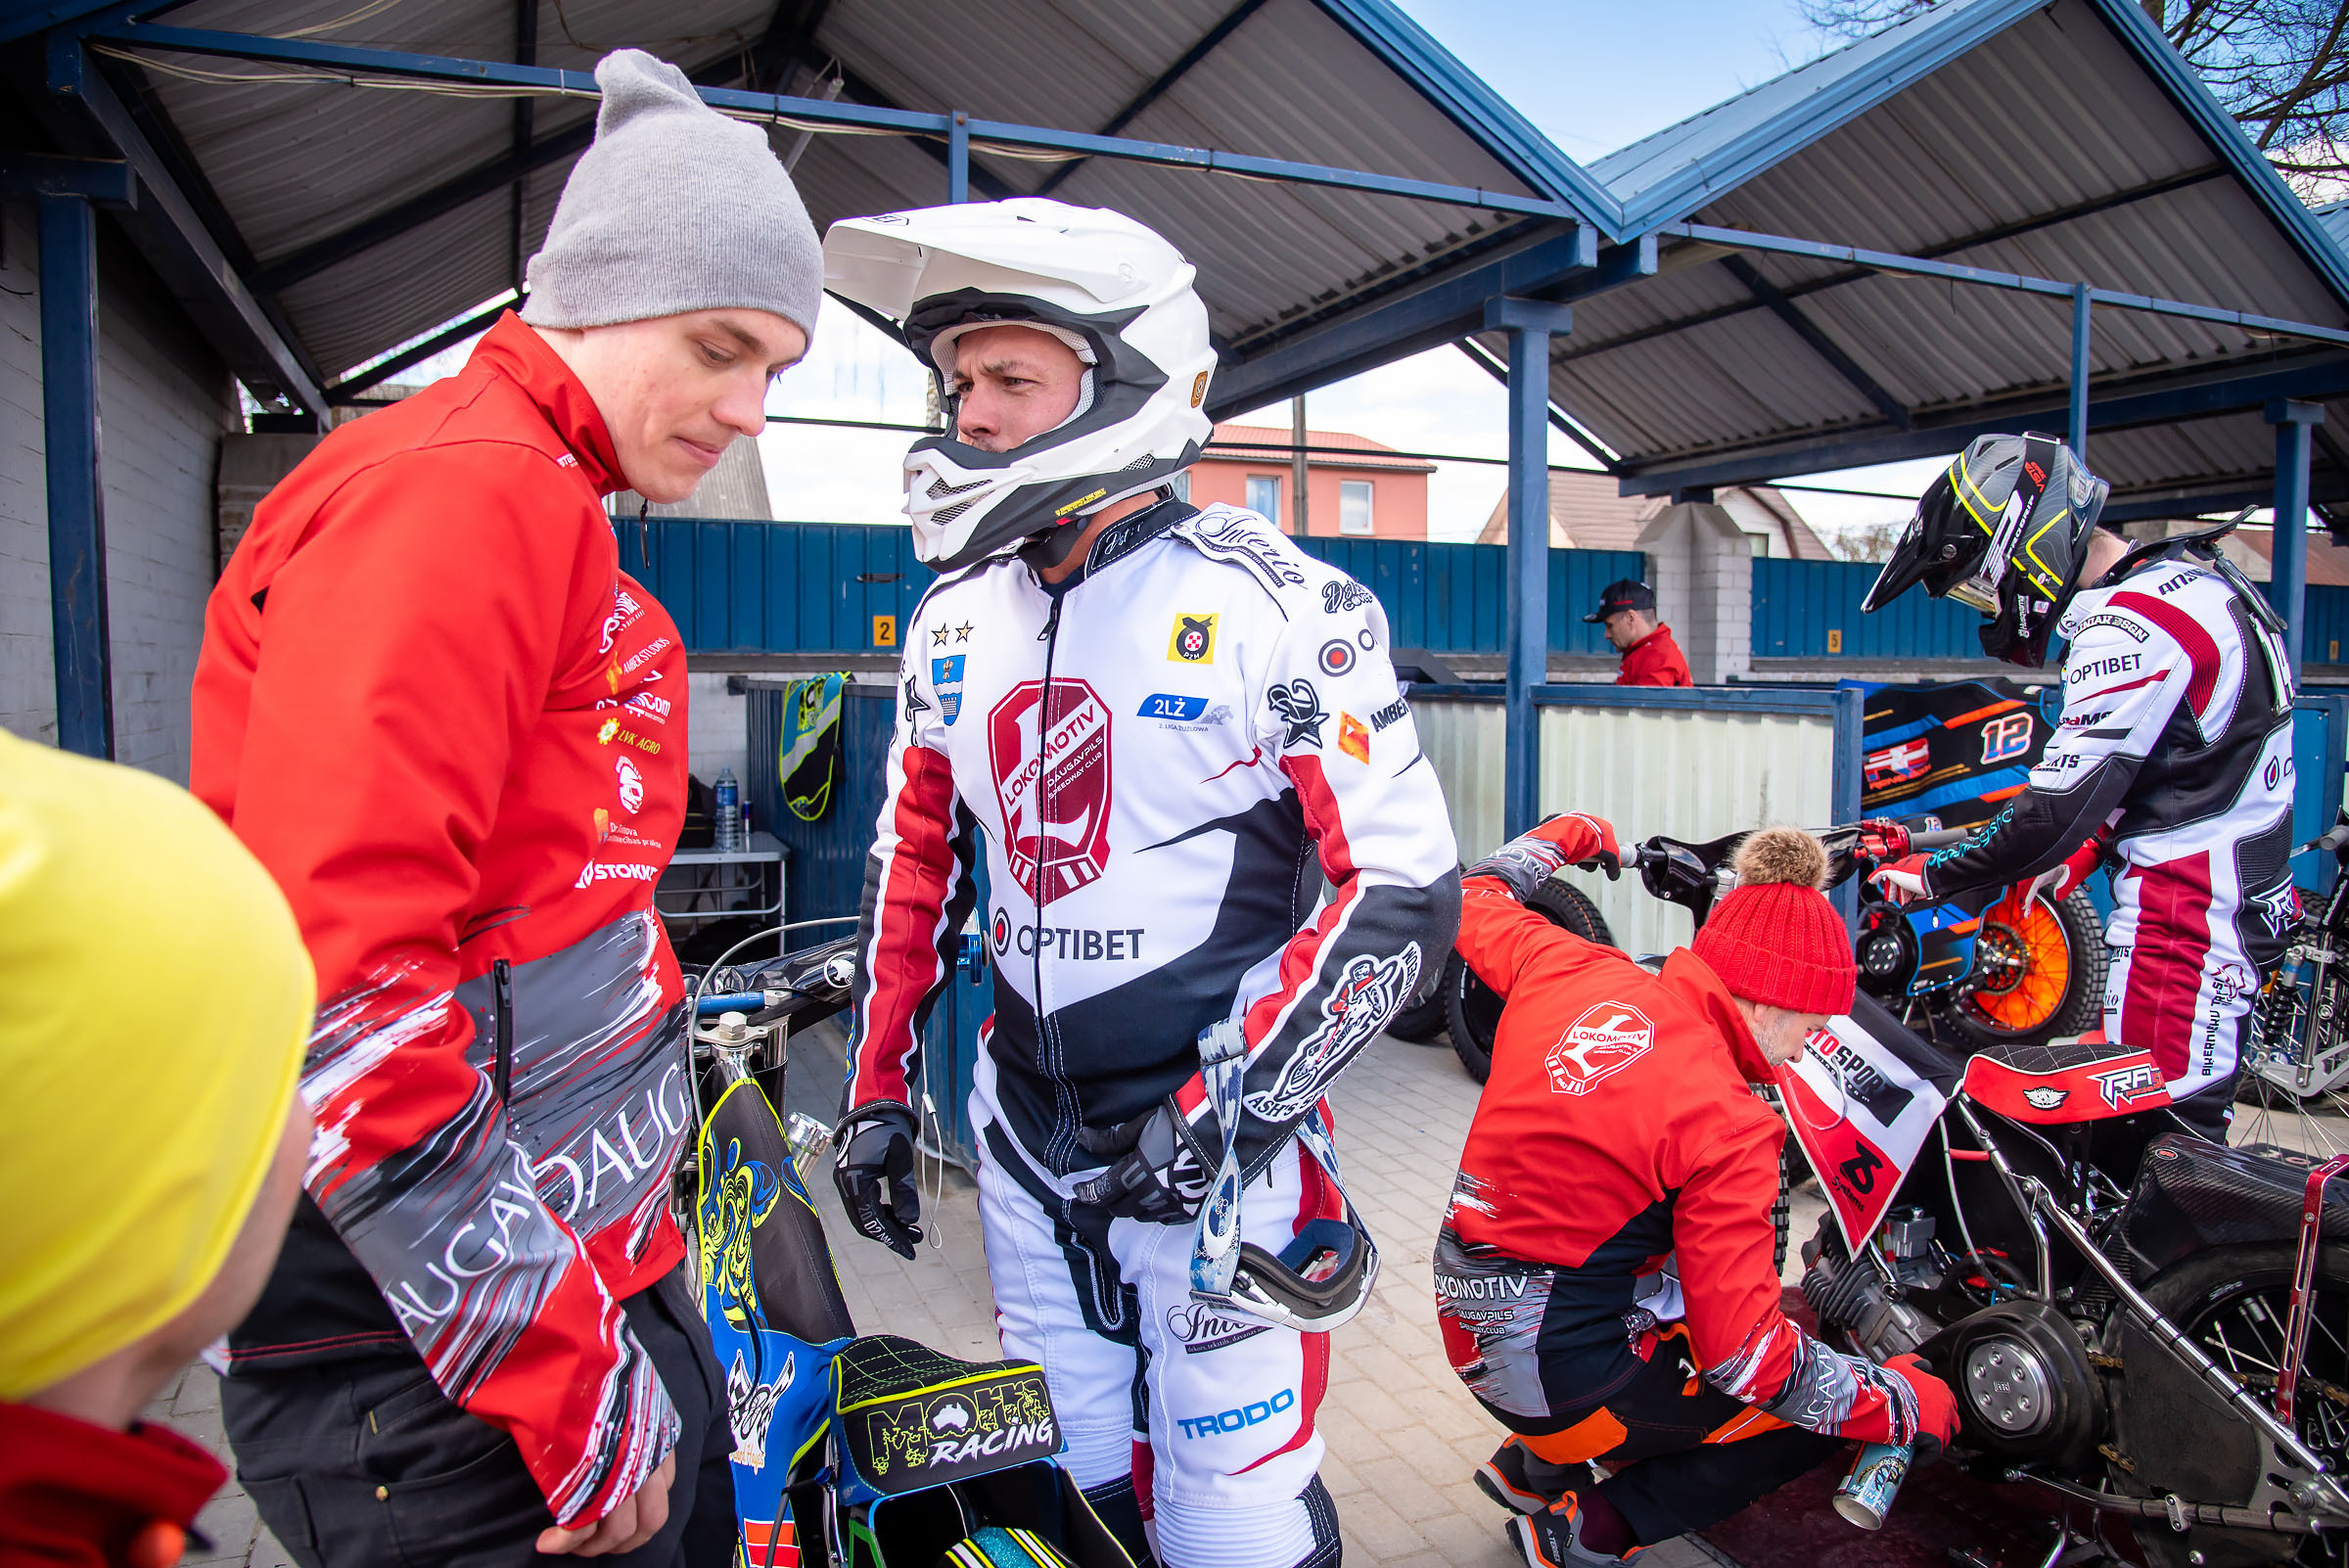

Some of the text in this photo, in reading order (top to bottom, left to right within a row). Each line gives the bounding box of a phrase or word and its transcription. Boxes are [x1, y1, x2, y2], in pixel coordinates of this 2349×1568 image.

[880, 622, 890, 640] 2
[2070, 653, 2142, 684] OPTIBET
[1154, 697, 1186, 717] 2LŻ
[618, 729, 662, 755] LVK AGRO
[1004, 704, 1094, 807] LOKOMOTIV
[1981, 712, 2033, 764] 12
[1046, 736, 1104, 788] DAUGAVPILS
[1048, 751, 1103, 800] SPEEDWAY CLUB
[1017, 924, 1145, 961] OPTIBET
[1832, 1176, 1865, 1213] Systems
[1435, 1273, 1529, 1301] OKOMOTIV
[1177, 1388, 1295, 1440] TRODO
[929, 1416, 1054, 1469] RACING
[1549, 1537, 1562, 1563] TERREX
